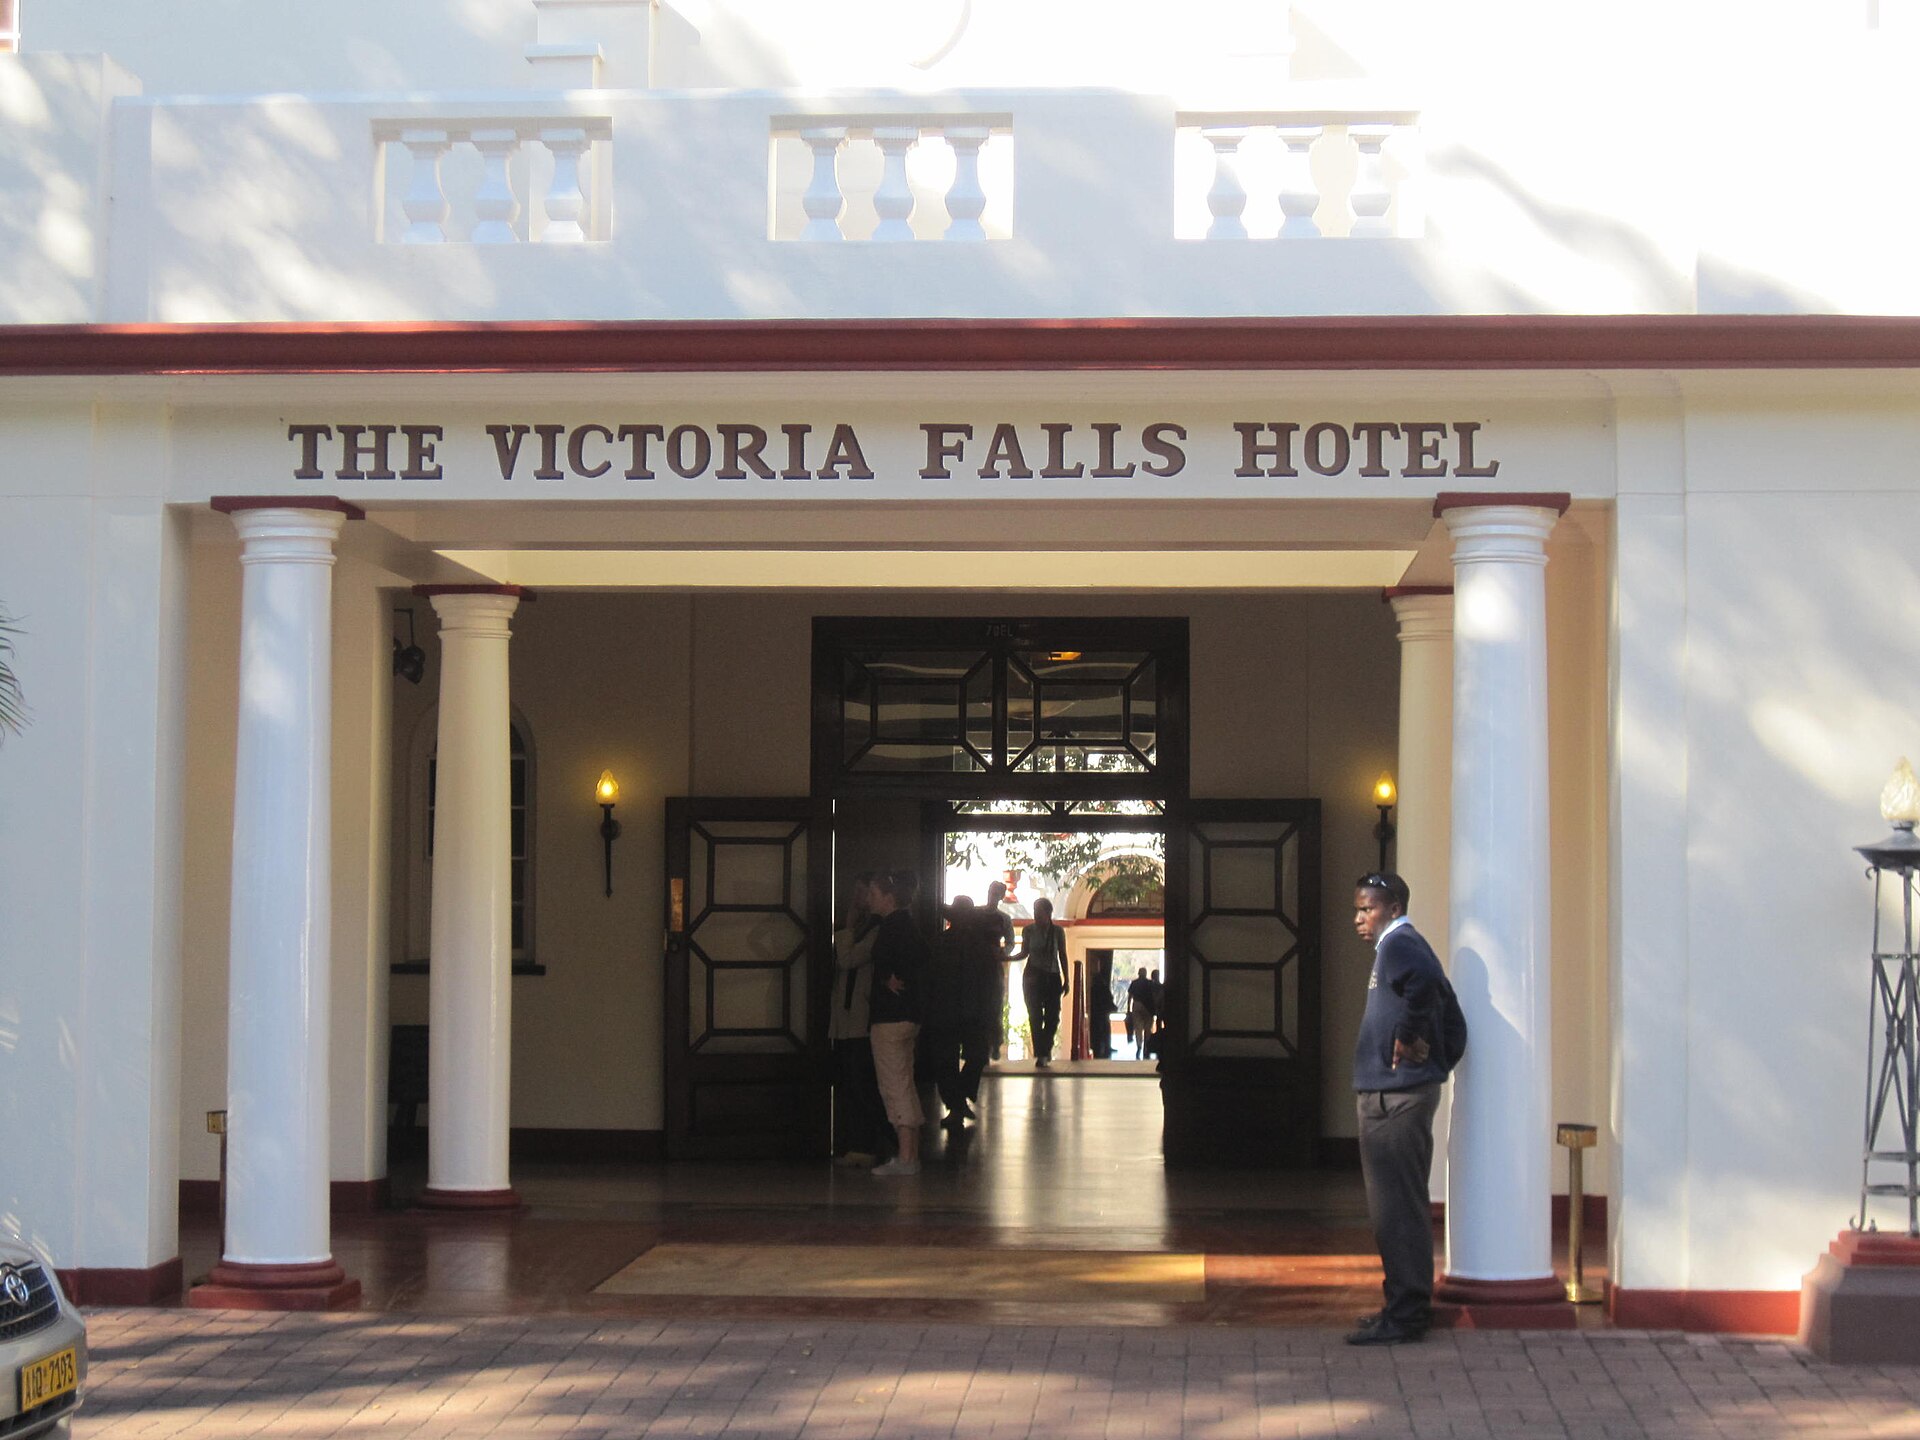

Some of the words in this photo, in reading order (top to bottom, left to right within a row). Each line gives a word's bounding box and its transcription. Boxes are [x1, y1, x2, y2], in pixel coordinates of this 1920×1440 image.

[287, 423, 444, 481] THE
[485, 423, 875, 481] VICTORIA
[919, 422, 1188, 481] FALLS
[1233, 421, 1500, 479] HOTEL
[48, 1352, 74, 1392] 7193
